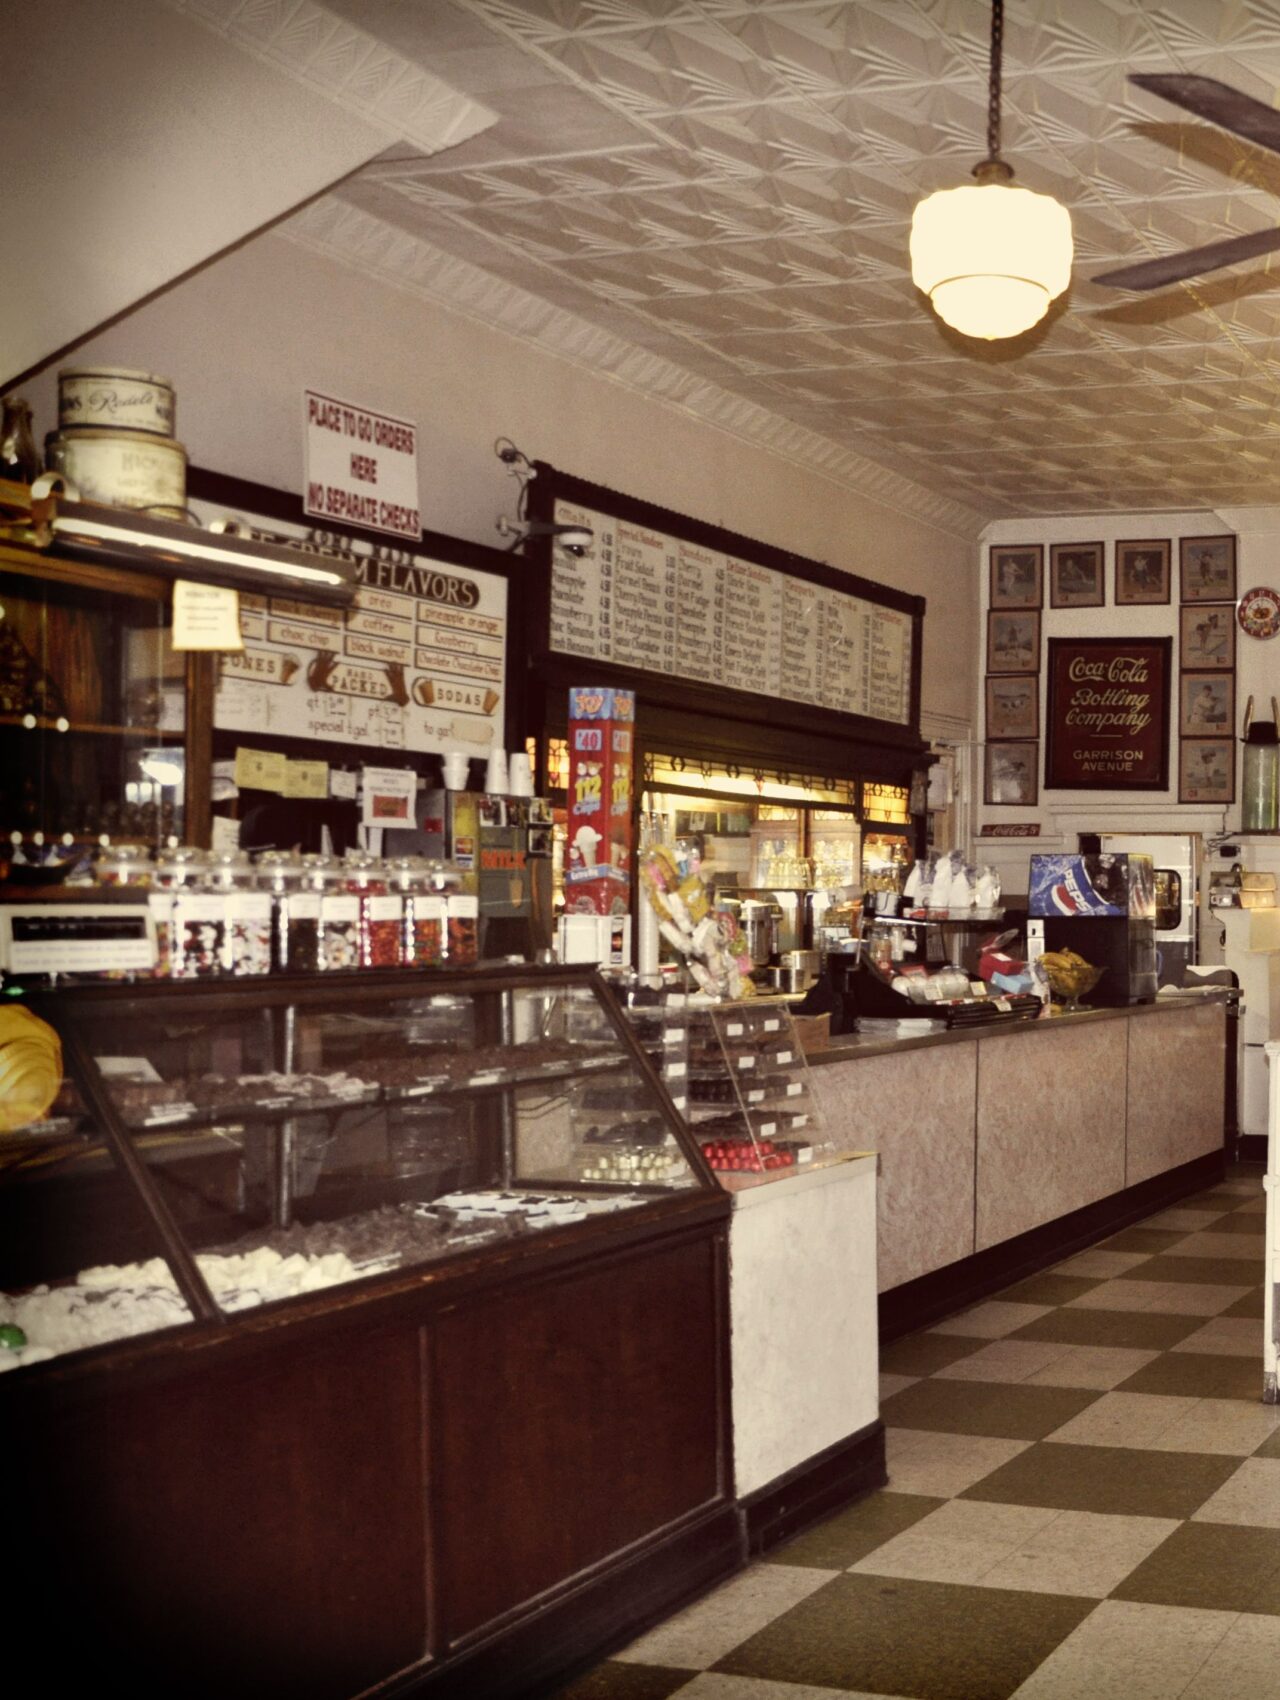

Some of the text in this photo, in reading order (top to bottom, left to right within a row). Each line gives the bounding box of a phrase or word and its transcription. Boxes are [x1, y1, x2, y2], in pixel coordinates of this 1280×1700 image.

[309, 398, 414, 455] PLACE TO GO ORDERS
[350, 453, 377, 484] HERE
[309, 482, 420, 535] NO SEPARATE CHECKS
[377, 562, 474, 607] FLAVORS
[332, 675, 389, 695] PACKED
[437, 687, 482, 706] SODAS
[576, 694, 604, 714] JOY
[1071, 688, 1151, 713] Bottling
[1065, 707, 1152, 736] Company
[1072, 750, 1144, 761] GARRISON
[1081, 761, 1134, 772] AVENUE
